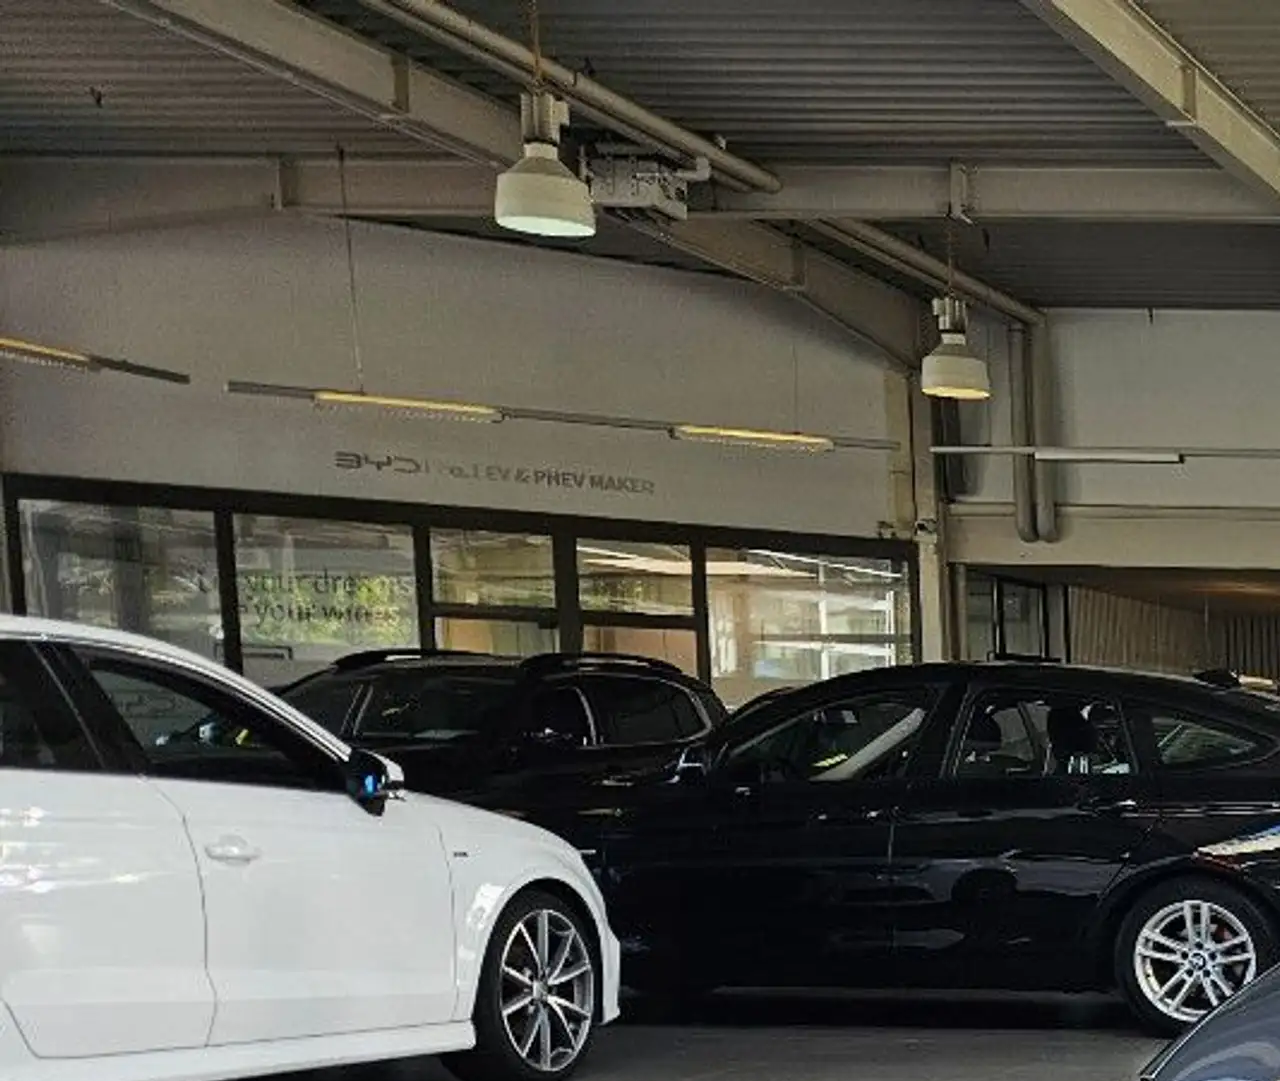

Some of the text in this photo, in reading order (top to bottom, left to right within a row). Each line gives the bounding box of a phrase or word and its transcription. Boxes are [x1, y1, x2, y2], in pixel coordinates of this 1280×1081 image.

[334, 449, 421, 473] BYD
[485, 465, 511, 482] EV
[534, 470, 585, 490] PHEV
[590, 474, 656, 496] MAKER
[253, 603, 316, 628] your
